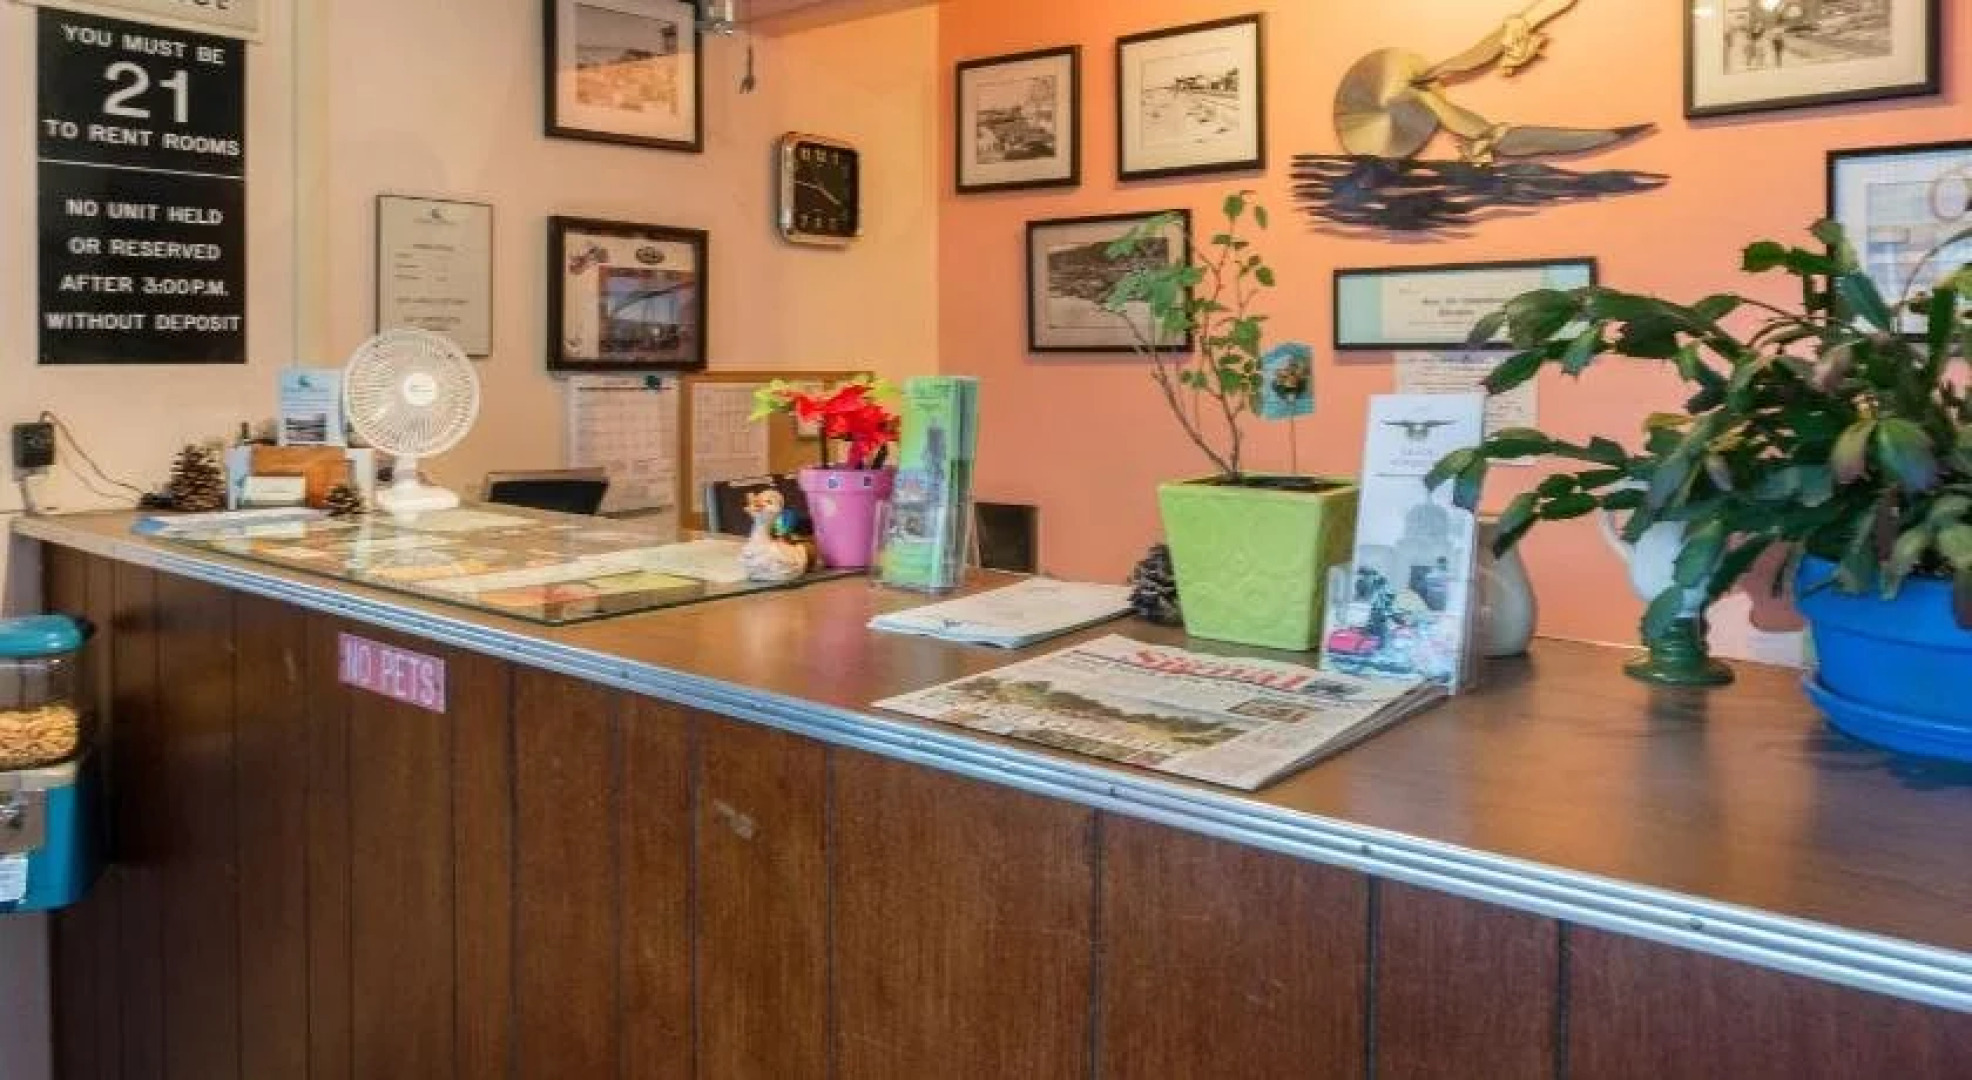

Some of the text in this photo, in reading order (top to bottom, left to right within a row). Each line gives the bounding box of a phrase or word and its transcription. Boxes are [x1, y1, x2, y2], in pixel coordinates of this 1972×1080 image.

[61, 24, 223, 64] YOU MUST BE
[102, 61, 188, 122] 21
[42, 119, 240, 155] TO RENT ROOMS
[66, 199, 223, 225] NO UNIT HELD
[68, 237, 221, 260] OR RESERVED
[60, 275, 132, 291] AFTER
[45, 312, 241, 331] WITHOUT DEPOSIT
[344, 638, 373, 685] NO
